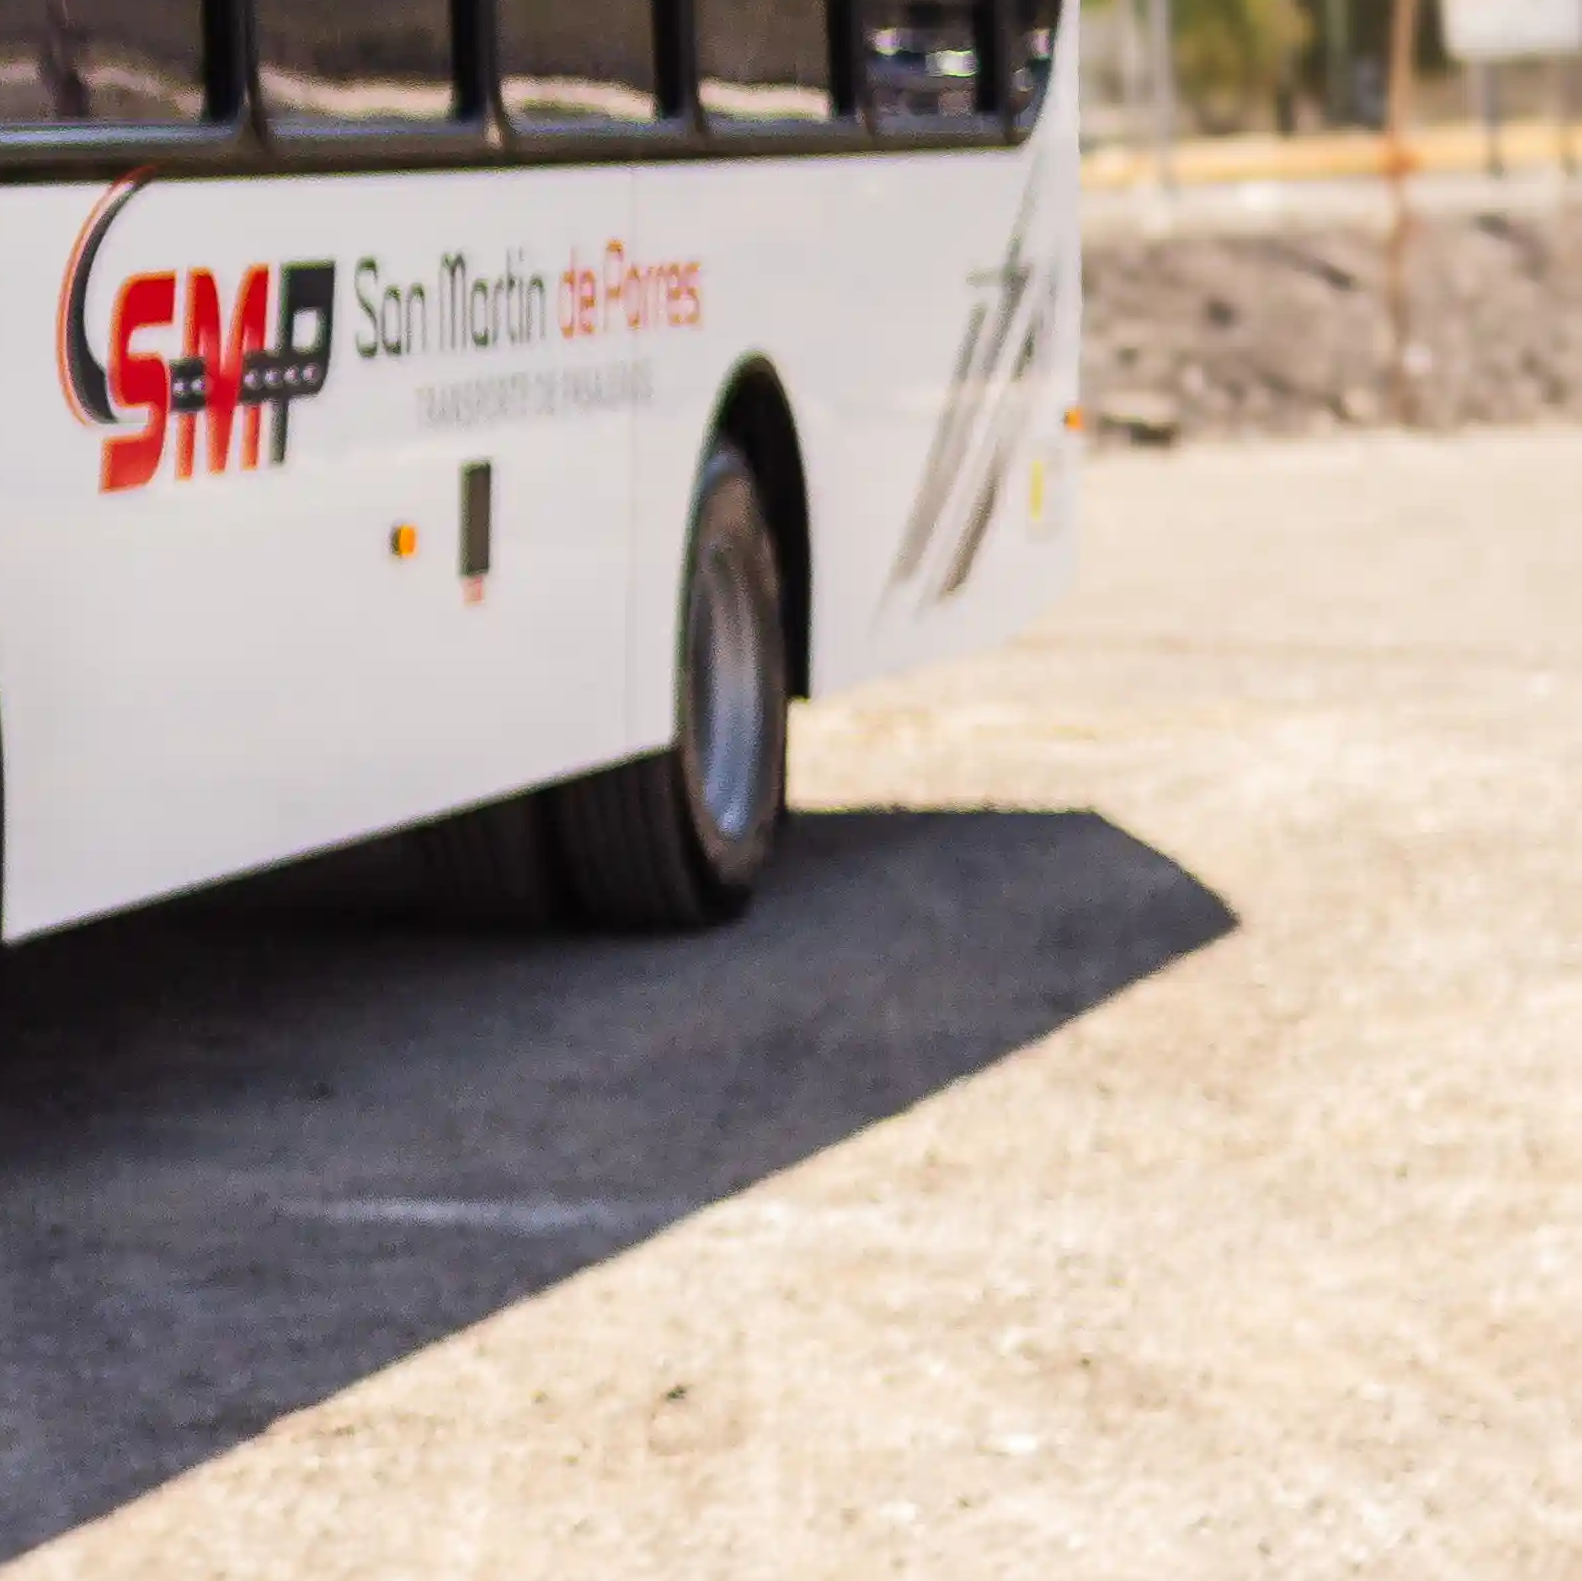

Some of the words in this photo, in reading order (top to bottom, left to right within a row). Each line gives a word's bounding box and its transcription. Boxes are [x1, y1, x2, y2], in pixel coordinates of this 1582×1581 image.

[99, 260, 336, 493] SMP
[353, 256, 427, 360] San
[558, 246, 596, 339] de
